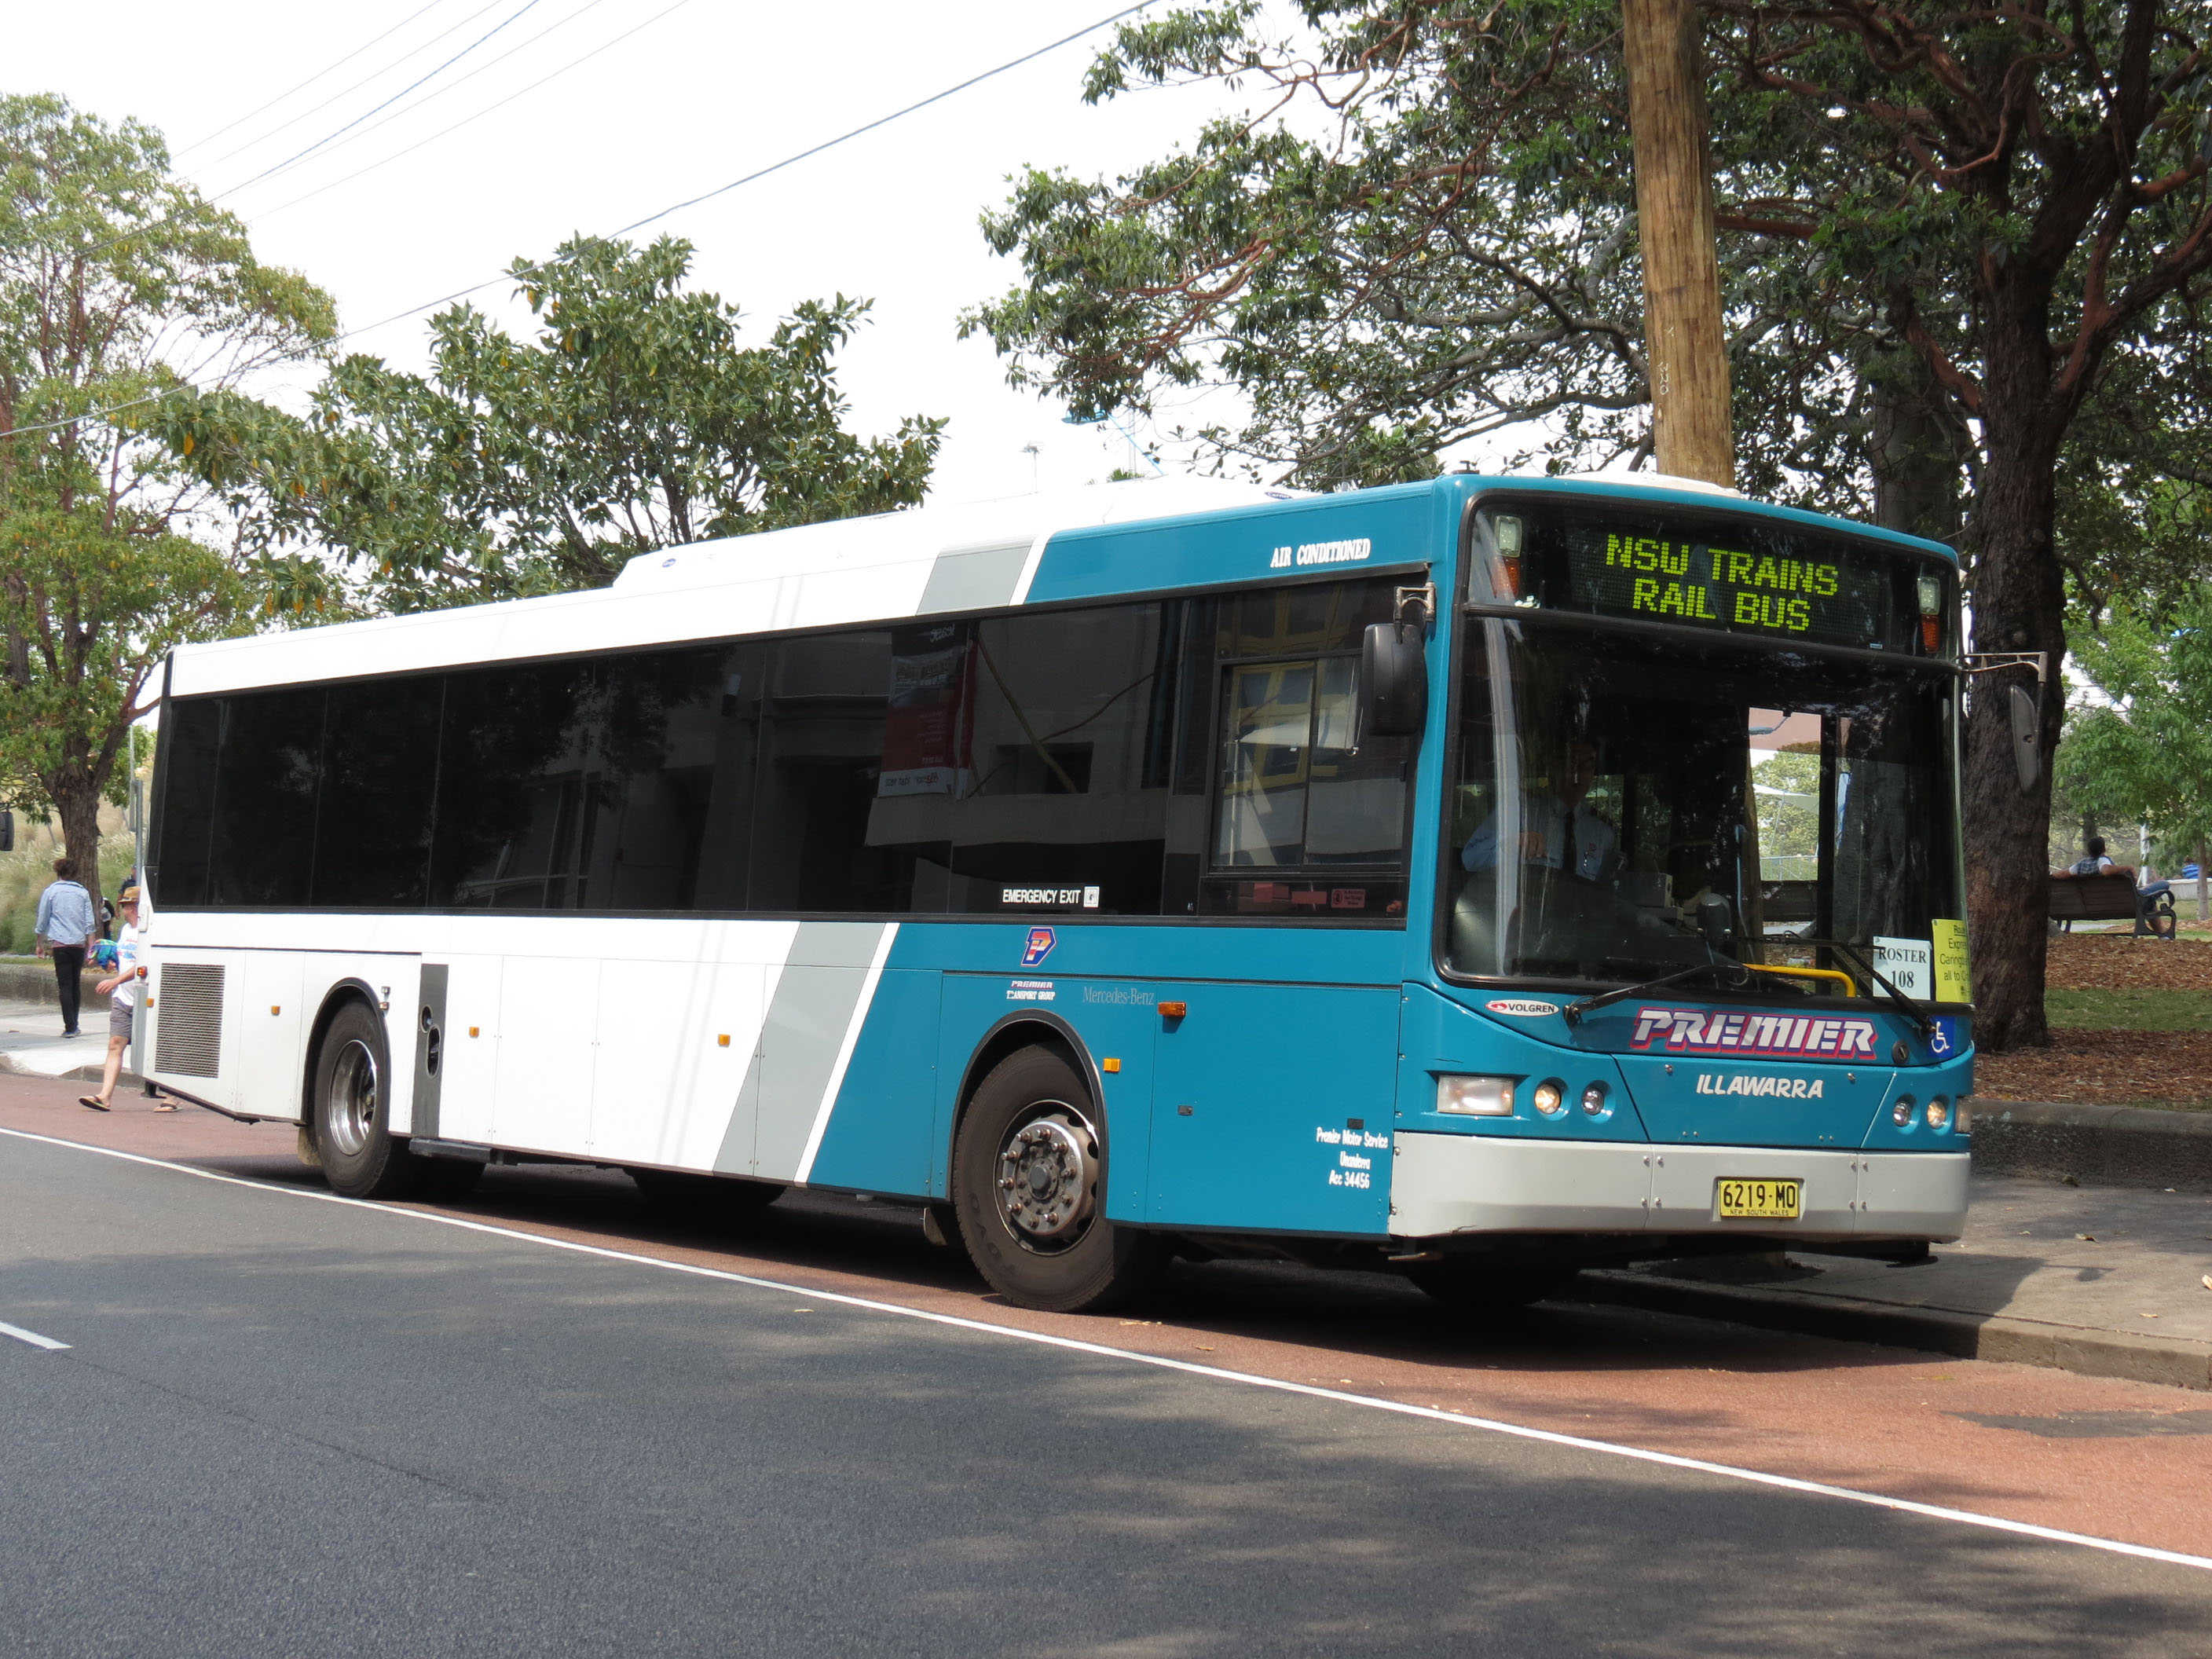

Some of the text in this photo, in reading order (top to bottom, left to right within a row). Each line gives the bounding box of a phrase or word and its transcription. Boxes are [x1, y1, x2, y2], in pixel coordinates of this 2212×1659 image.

[1270, 538, 1371, 567] AIR CONDITIONED
[1606, 534, 1838, 595] NSW TRAINS
[1632, 578, 1810, 631] RAIL BUS
[1002, 889, 1081, 903] EMERGENCY EXIT
[1878, 947, 1927, 964] ROSTER
[1010, 980, 1053, 989] PREMIER
[1891, 970, 1914, 988] 108
[1954, 971, 1961, 981] to
[1038, 991, 1055, 1000] GROUP
[1083, 987, 1154, 1005] Mercedes-Benz
[1508, 1003, 1555, 1013] VOLGREN
[1631, 1008, 1878, 1058] PREMIER
[1696, 1074, 1823, 1099] ILLAWARRA
[1317, 1126, 1388, 1148] Premier Motor Service
[1340, 1151, 1371, 1170] Unanderra
[1344, 1171, 1370, 1188] 34456
